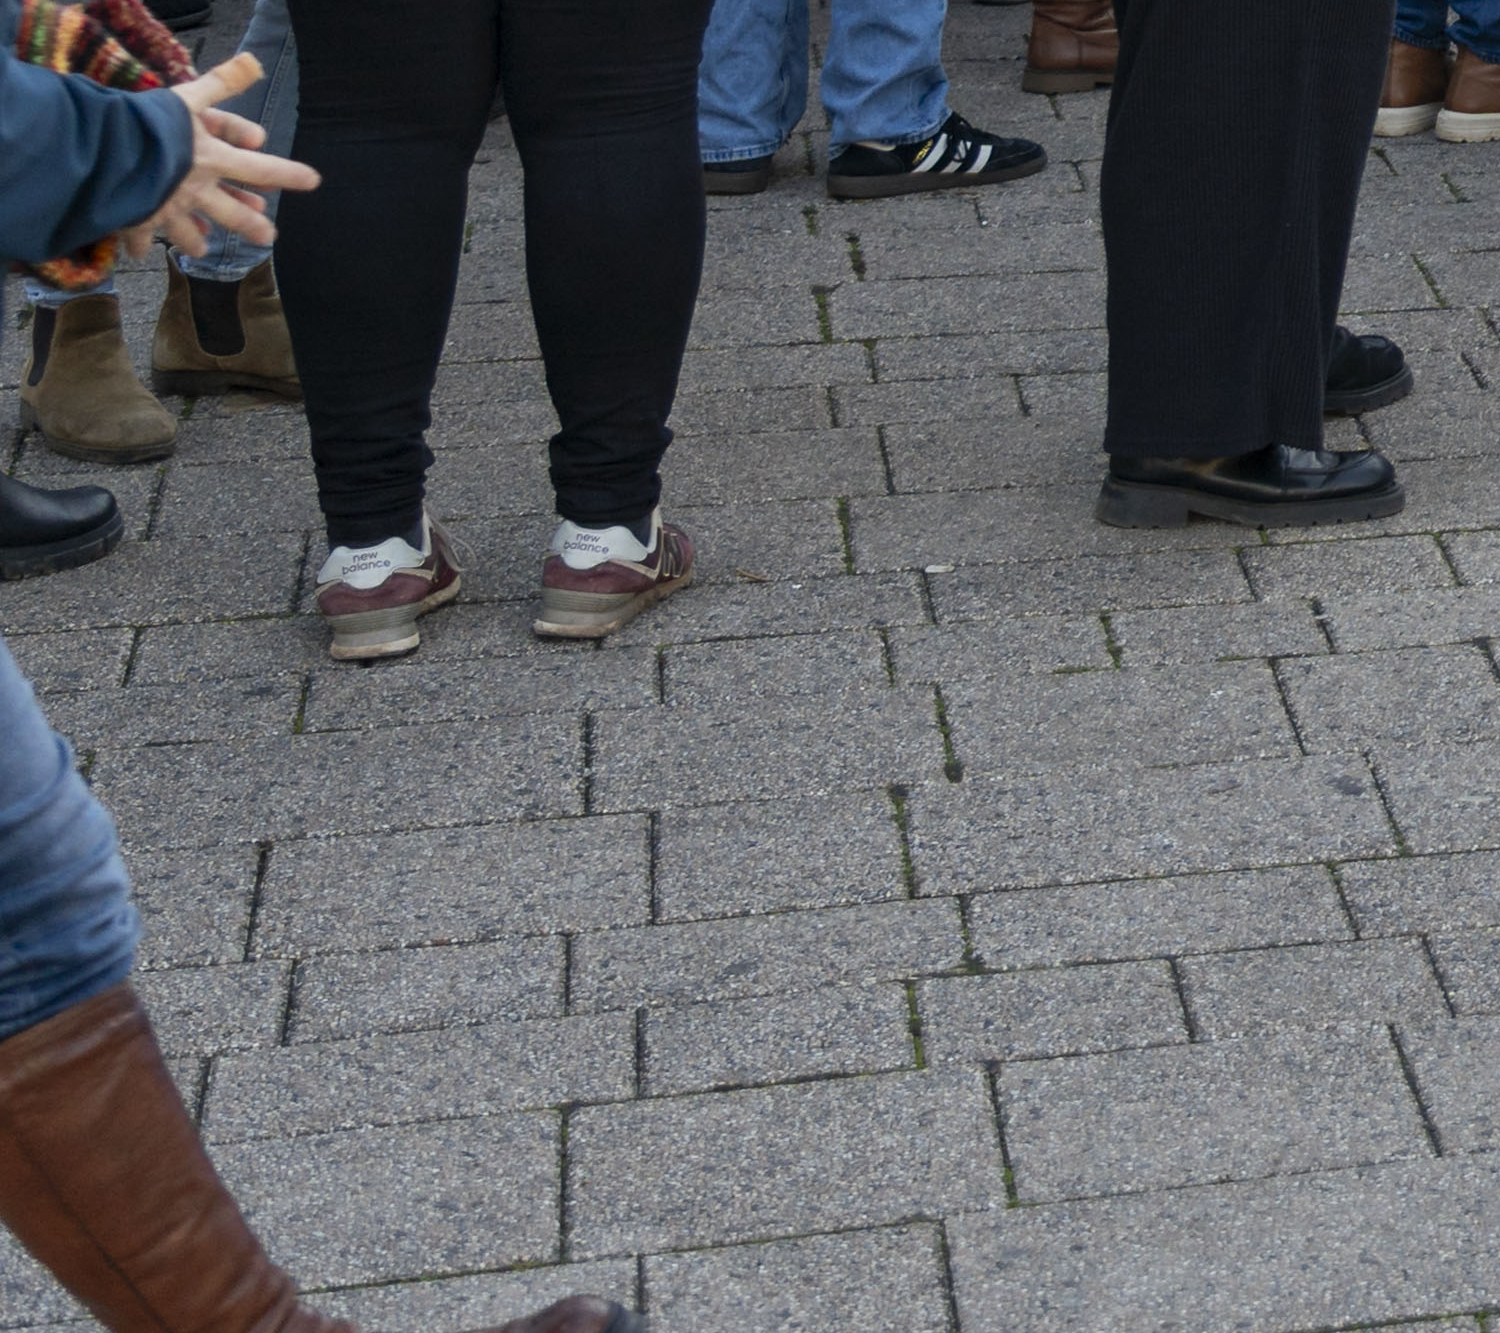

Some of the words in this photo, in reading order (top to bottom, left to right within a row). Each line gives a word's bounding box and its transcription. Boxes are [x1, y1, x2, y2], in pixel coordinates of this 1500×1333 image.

[576, 532, 601, 544] new
[563, 539, 610, 555] balance
[352, 551, 378, 564] new
[341, 559, 392, 576] balance
